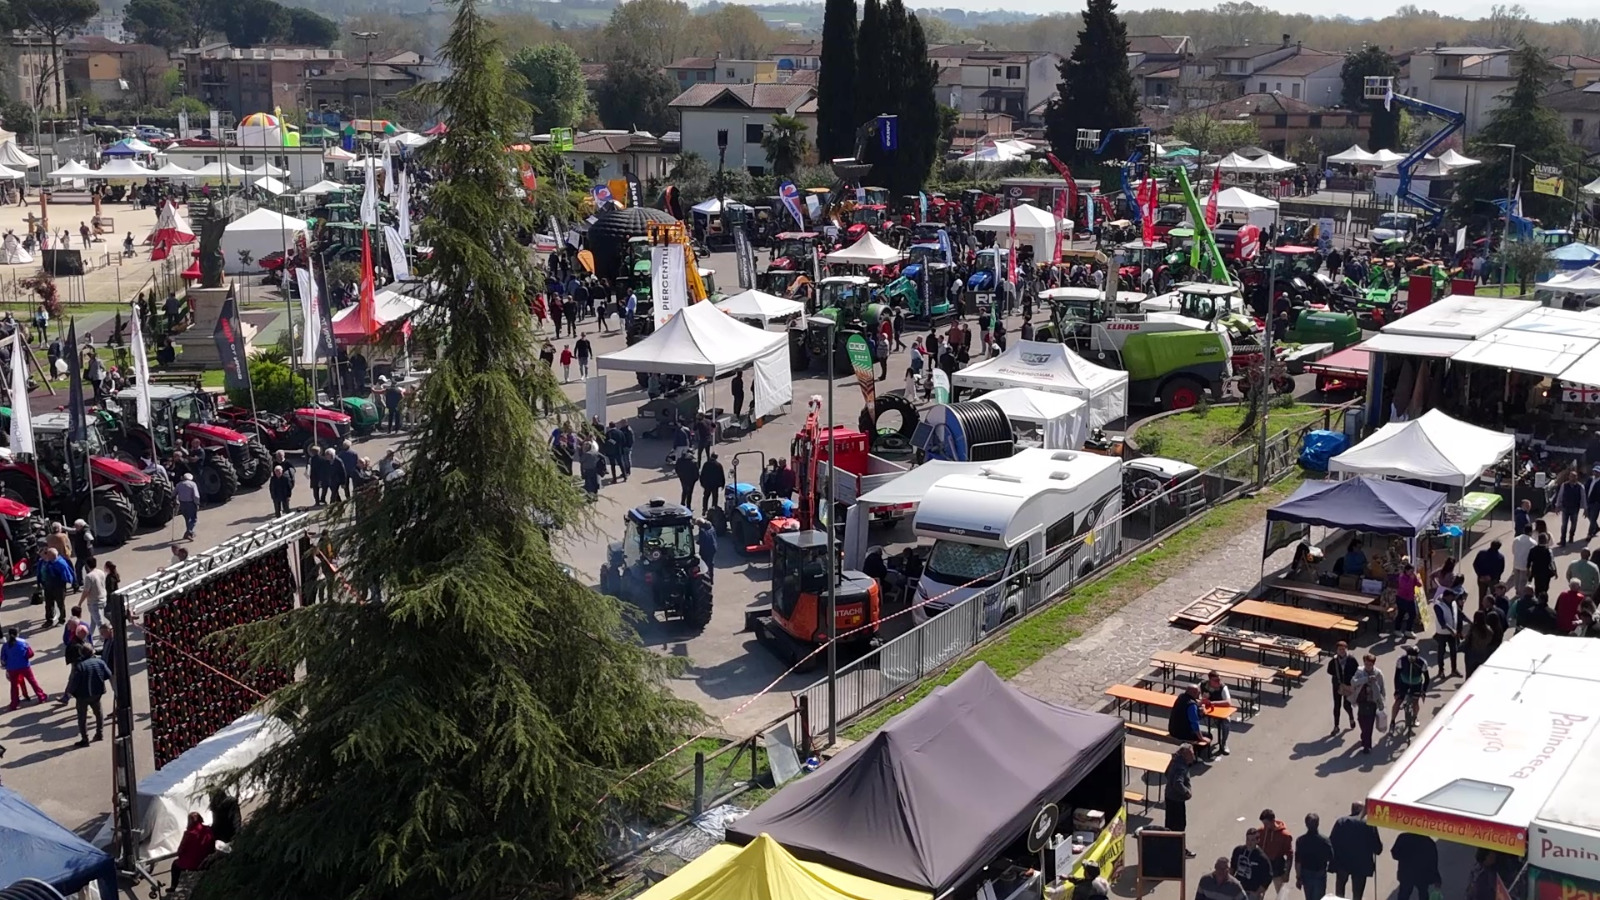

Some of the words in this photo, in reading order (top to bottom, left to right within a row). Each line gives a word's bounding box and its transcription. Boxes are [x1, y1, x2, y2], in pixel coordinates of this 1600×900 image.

[1106, 323, 1140, 331] CLAAS
[1021, 352, 1051, 364] BKT
[1477, 719, 1506, 753] Marco
[1509, 710, 1589, 780] Paninoteca
[1395, 811, 1455, 834] Porchetta
[1472, 826, 1517, 848] Ariccia
[1541, 838, 1599, 861] Panin
